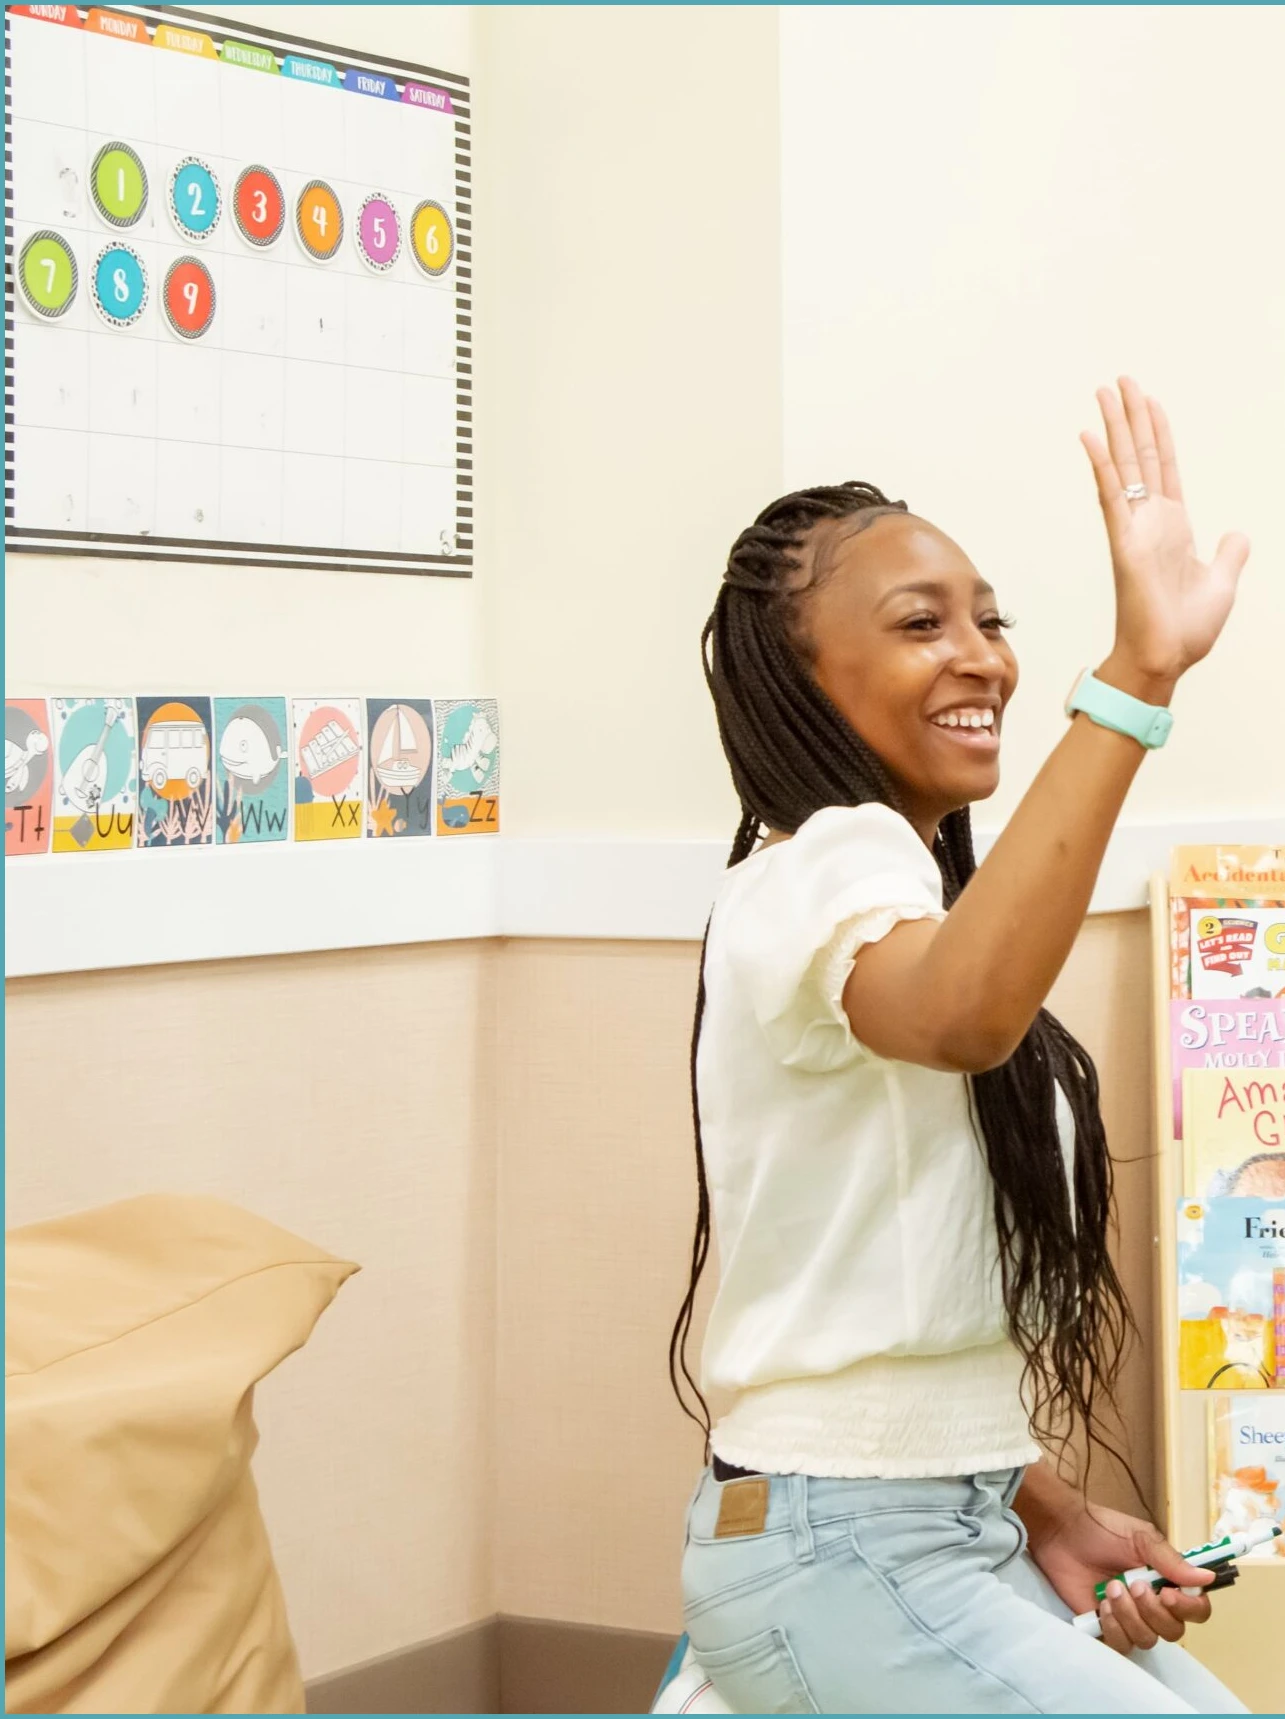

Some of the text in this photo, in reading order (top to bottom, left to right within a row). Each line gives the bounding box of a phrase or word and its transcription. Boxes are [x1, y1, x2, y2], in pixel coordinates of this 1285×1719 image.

[29, 5, 67, 21] SUNDAY
[100, 16, 138, 38] MONDAY
[165, 30, 204, 53] TUESDAY
[290, 60, 333, 83] THURSDAY
[357, 76, 386, 96] FRIDAY
[409, 87, 445, 109] SATURDAY
[116, 167, 439, 254] 1 2 3 4 5 6
[40, 259, 199, 315] 7 8 9
[96, 802, 133, 838] Uu
[240, 800, 287, 834] Ww
[332, 794, 360, 827] Xx
[400, 786, 430, 829] Yy
[469, 790, 496, 822] Zz
[13, 805, 44, 843] Tt
[1205, 922, 1214, 934] 2
[1226, 932, 1253, 943] READ
[1204, 951, 1250, 967] FIND OUT
